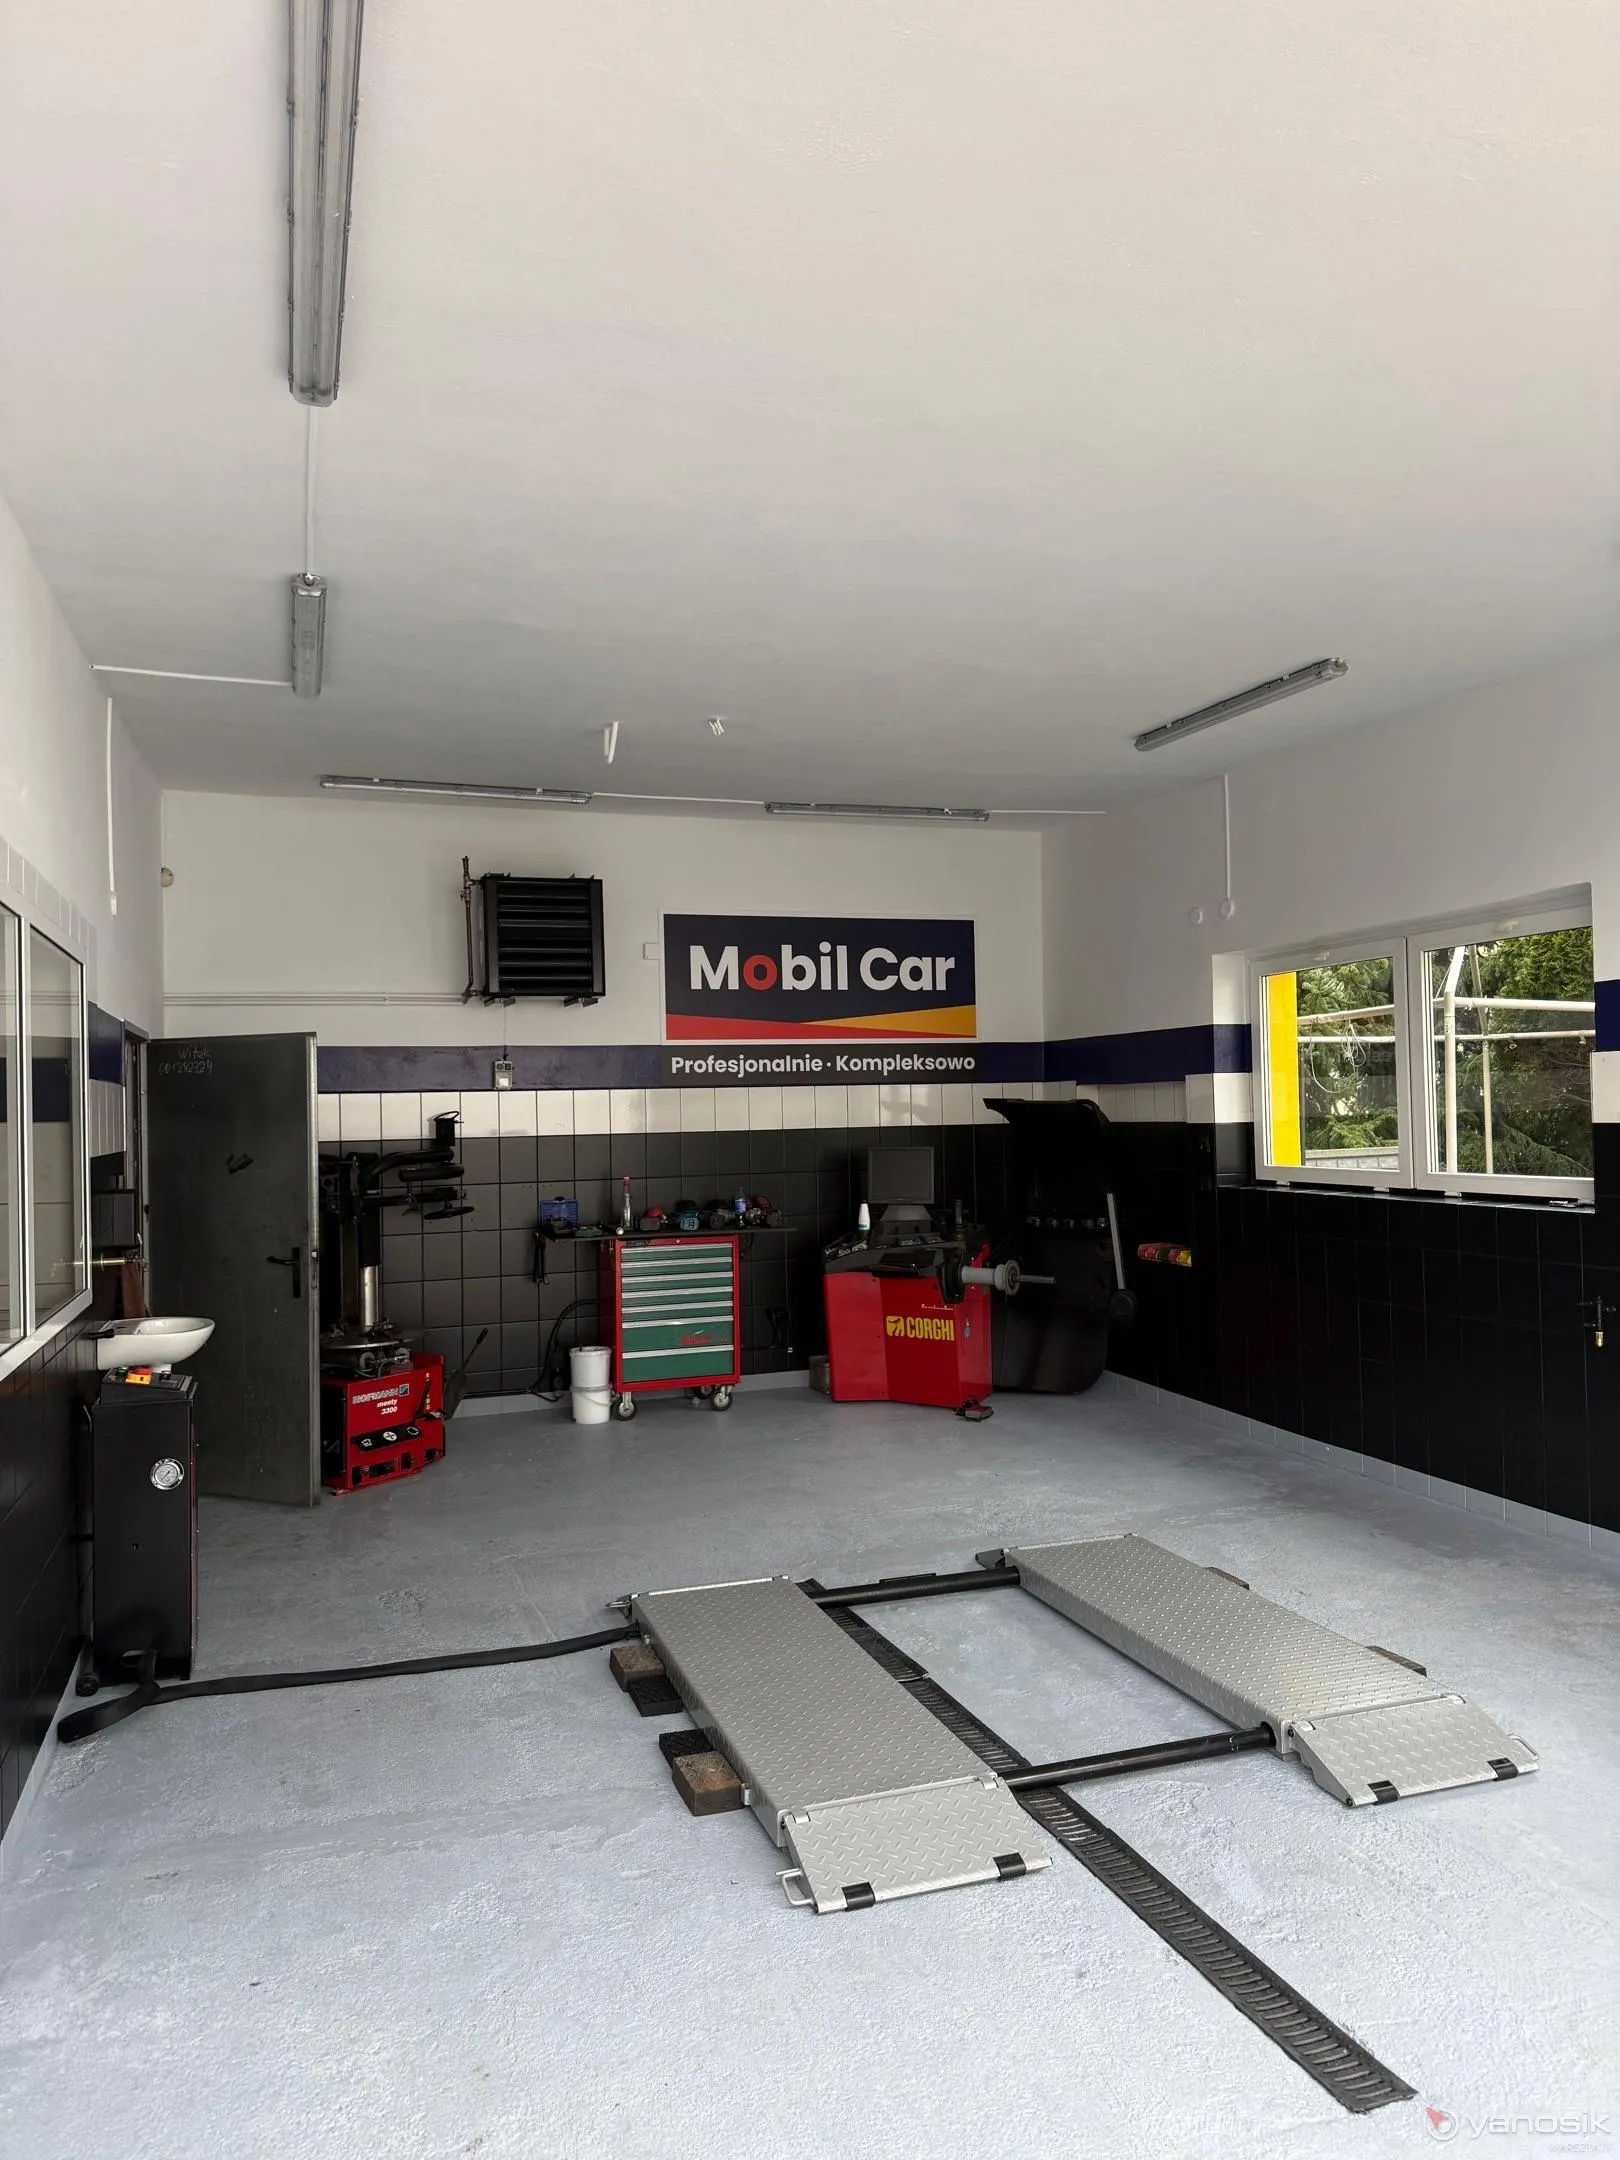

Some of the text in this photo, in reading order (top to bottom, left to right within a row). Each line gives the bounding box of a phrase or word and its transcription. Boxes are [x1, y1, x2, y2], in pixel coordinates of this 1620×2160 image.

[689, 941, 955, 991] Mobil Car
[671, 1053, 976, 1078] Profesjonalnie Kompleksowo
[906, 1317, 955, 1341] CORGHI
[377, 1399, 398, 1408] monty
[380, 1406, 398, 1415] 3300
